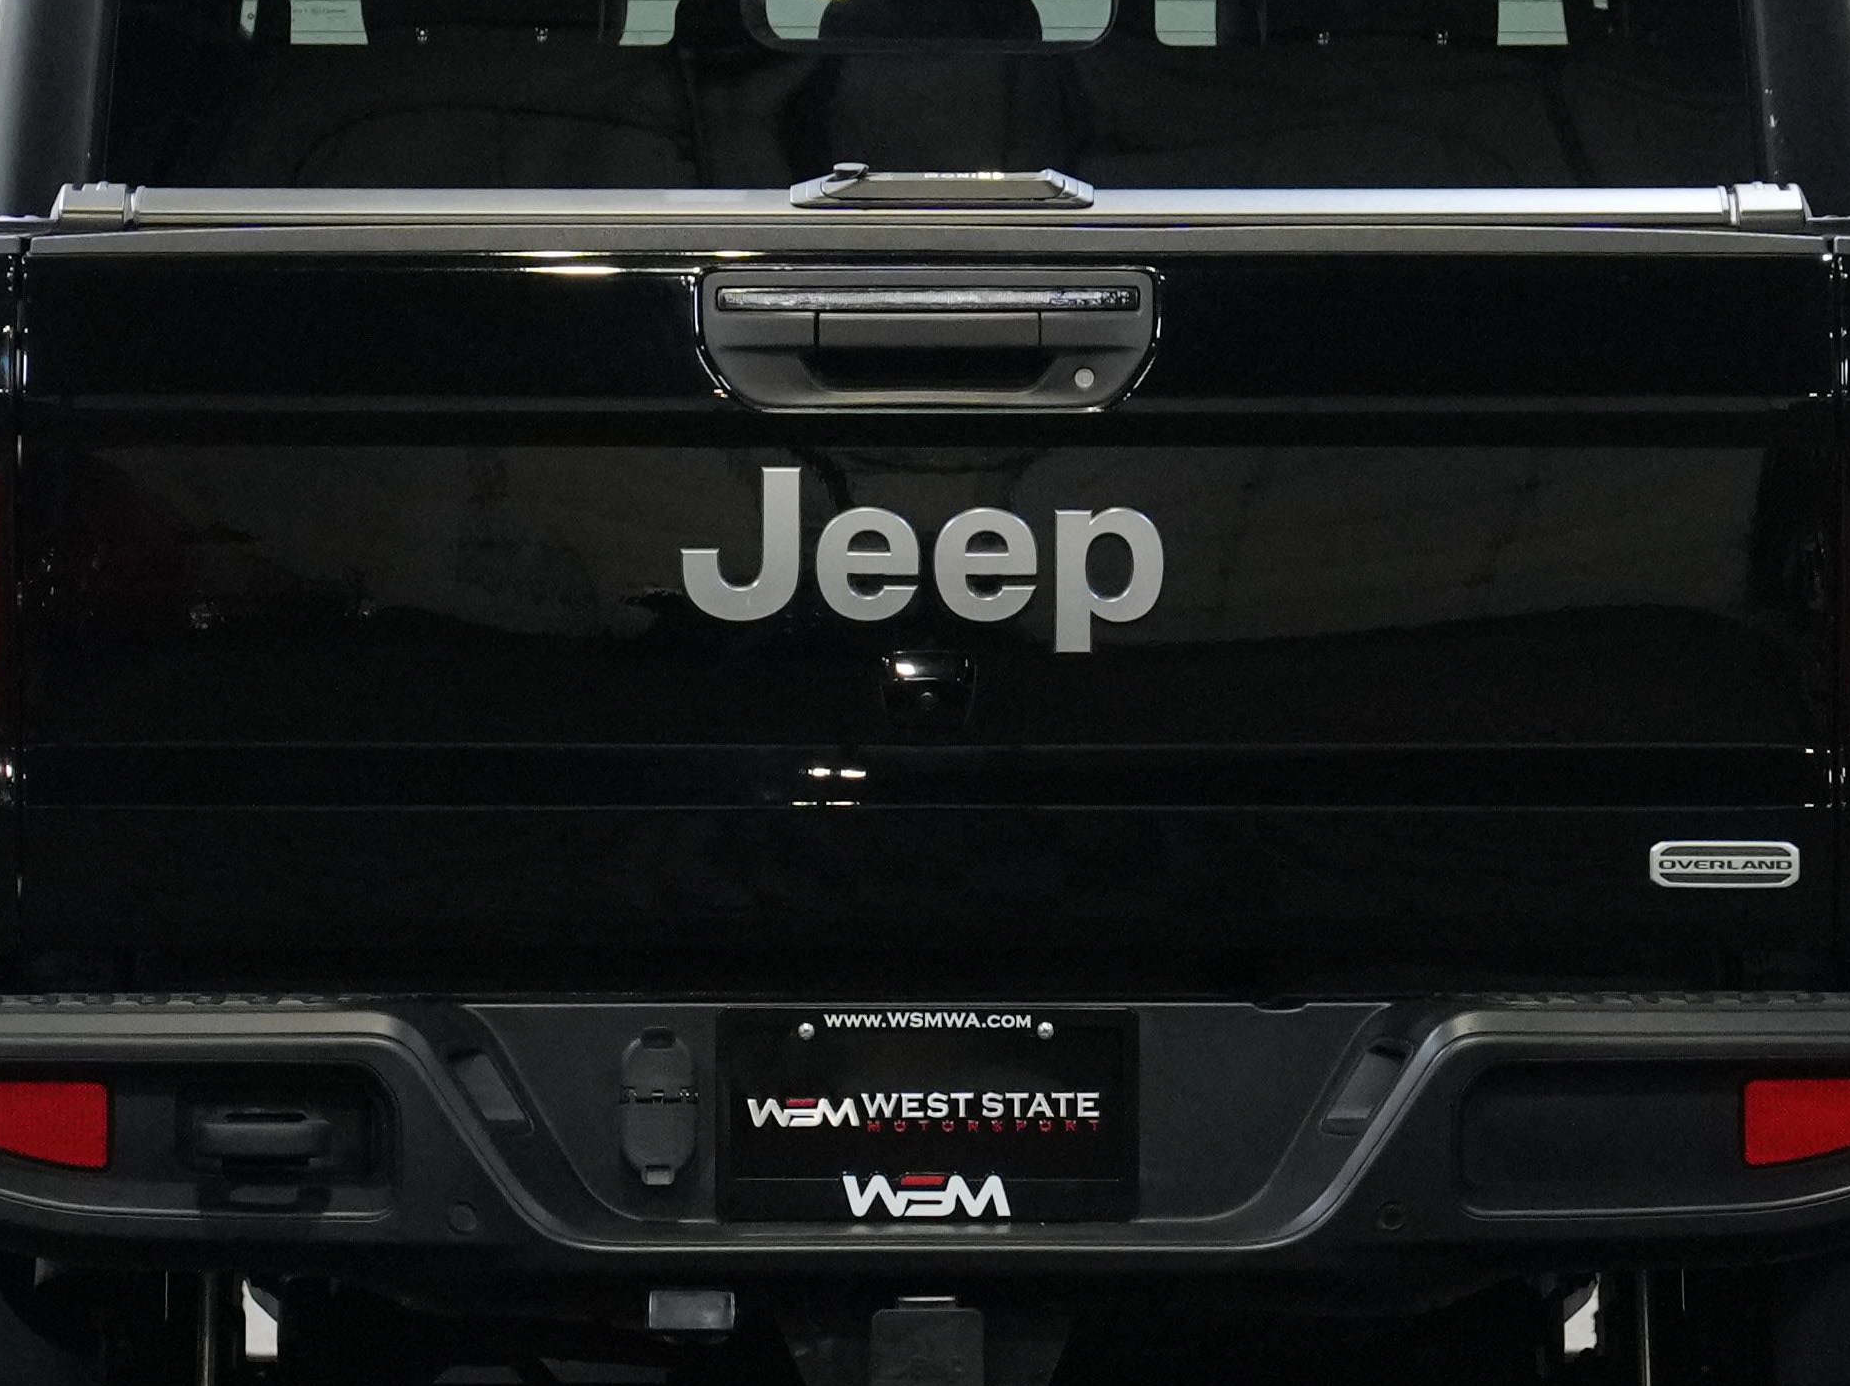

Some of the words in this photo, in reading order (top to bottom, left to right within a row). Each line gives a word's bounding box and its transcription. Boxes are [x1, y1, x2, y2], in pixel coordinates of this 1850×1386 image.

[680, 467, 1164, 653] Jeep
[1658, 859, 1793, 870] OVERLAND
[823, 1011, 1032, 1029] WWW.WSMWA.COM
[860, 1092, 975, 1118] WEST
[981, 1092, 1101, 1118] STATE
[866, 1119, 1100, 1133] MOTORSPORT
